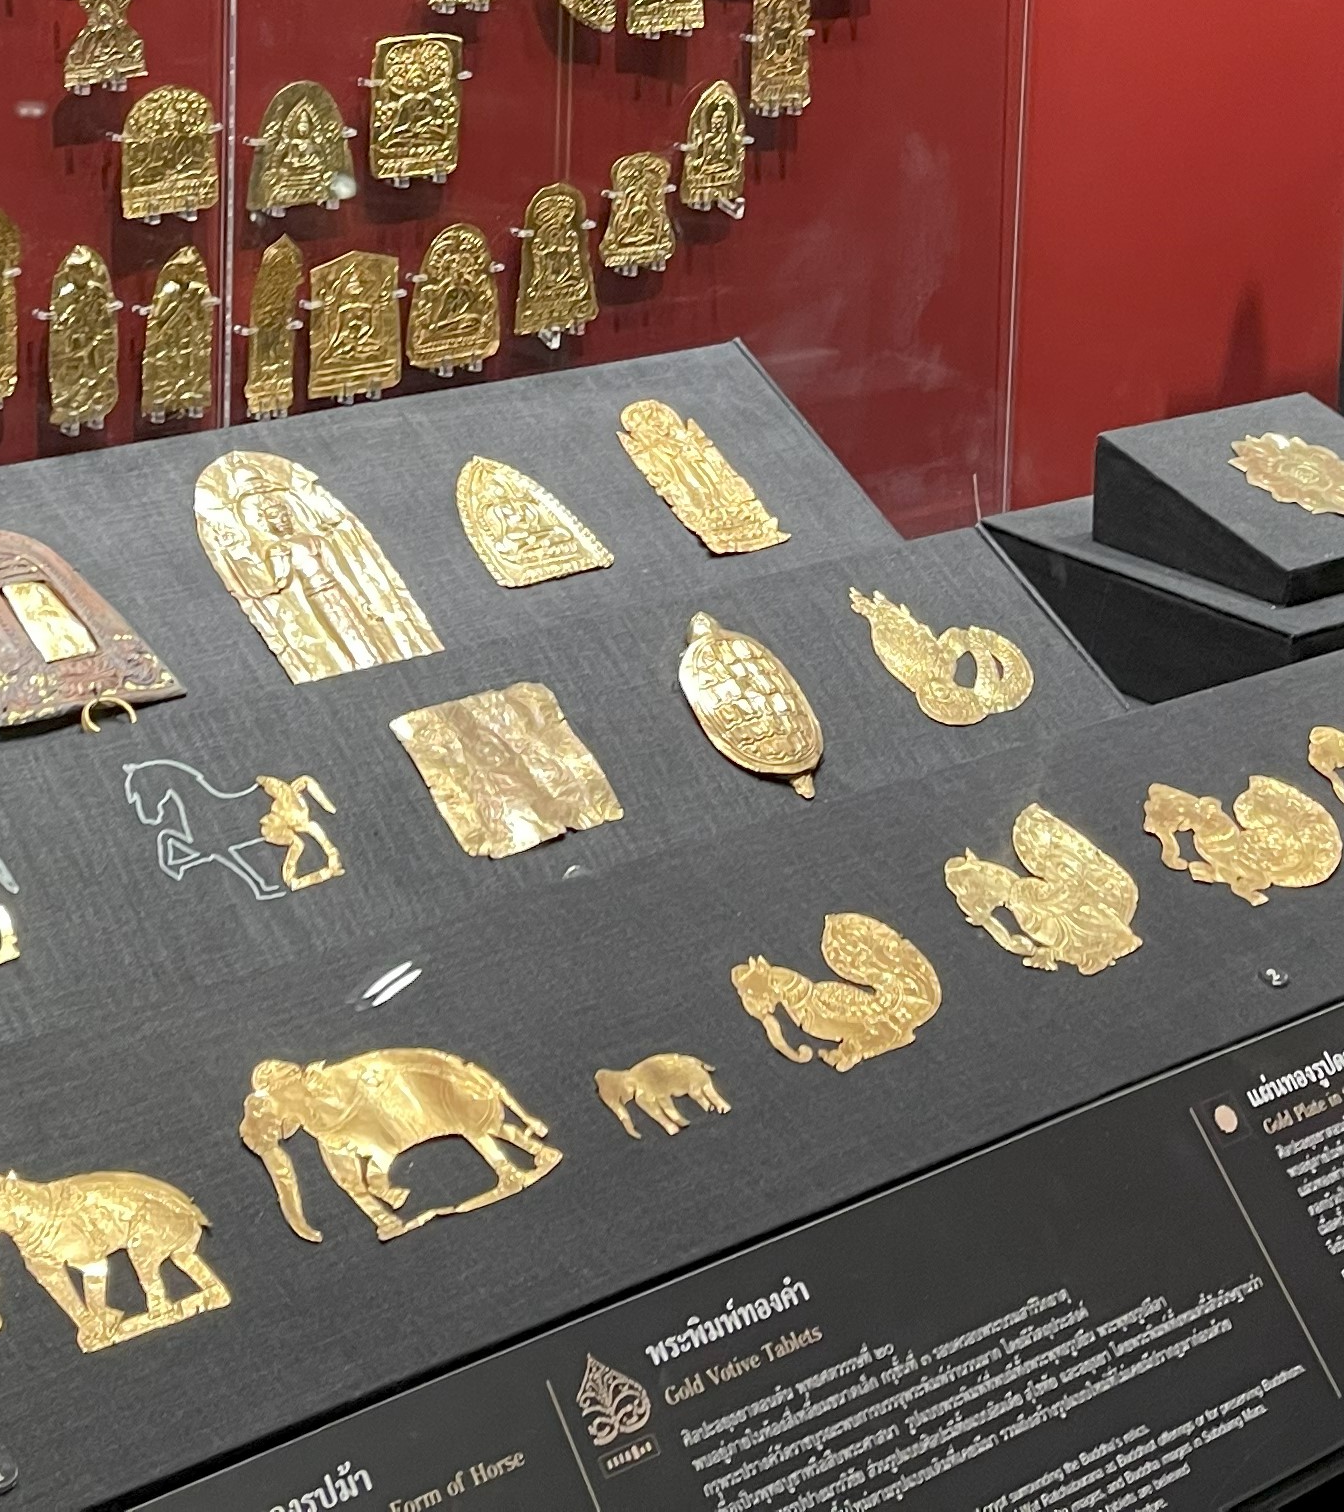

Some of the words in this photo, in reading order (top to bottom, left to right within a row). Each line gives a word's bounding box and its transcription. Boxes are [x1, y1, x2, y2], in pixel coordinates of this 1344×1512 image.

[1266, 968, 1282, 986] 2
[1262, 1108, 1294, 1134] Gold
[1292, 1099, 1328, 1122] Plate
[1325, 1091, 1343, 1107] in
[645, 1276, 810, 1366] พระพิมพ์ทองคำ
[664, 1372, 705, 1405] Gold
[705, 1354, 761, 1385] Votive
[760, 1326, 823, 1362] Tablets
[387, 1488, 443, 1512] Form
[446, 1470, 465, 1497] of
[469, 1451, 527, 1487] Horse
